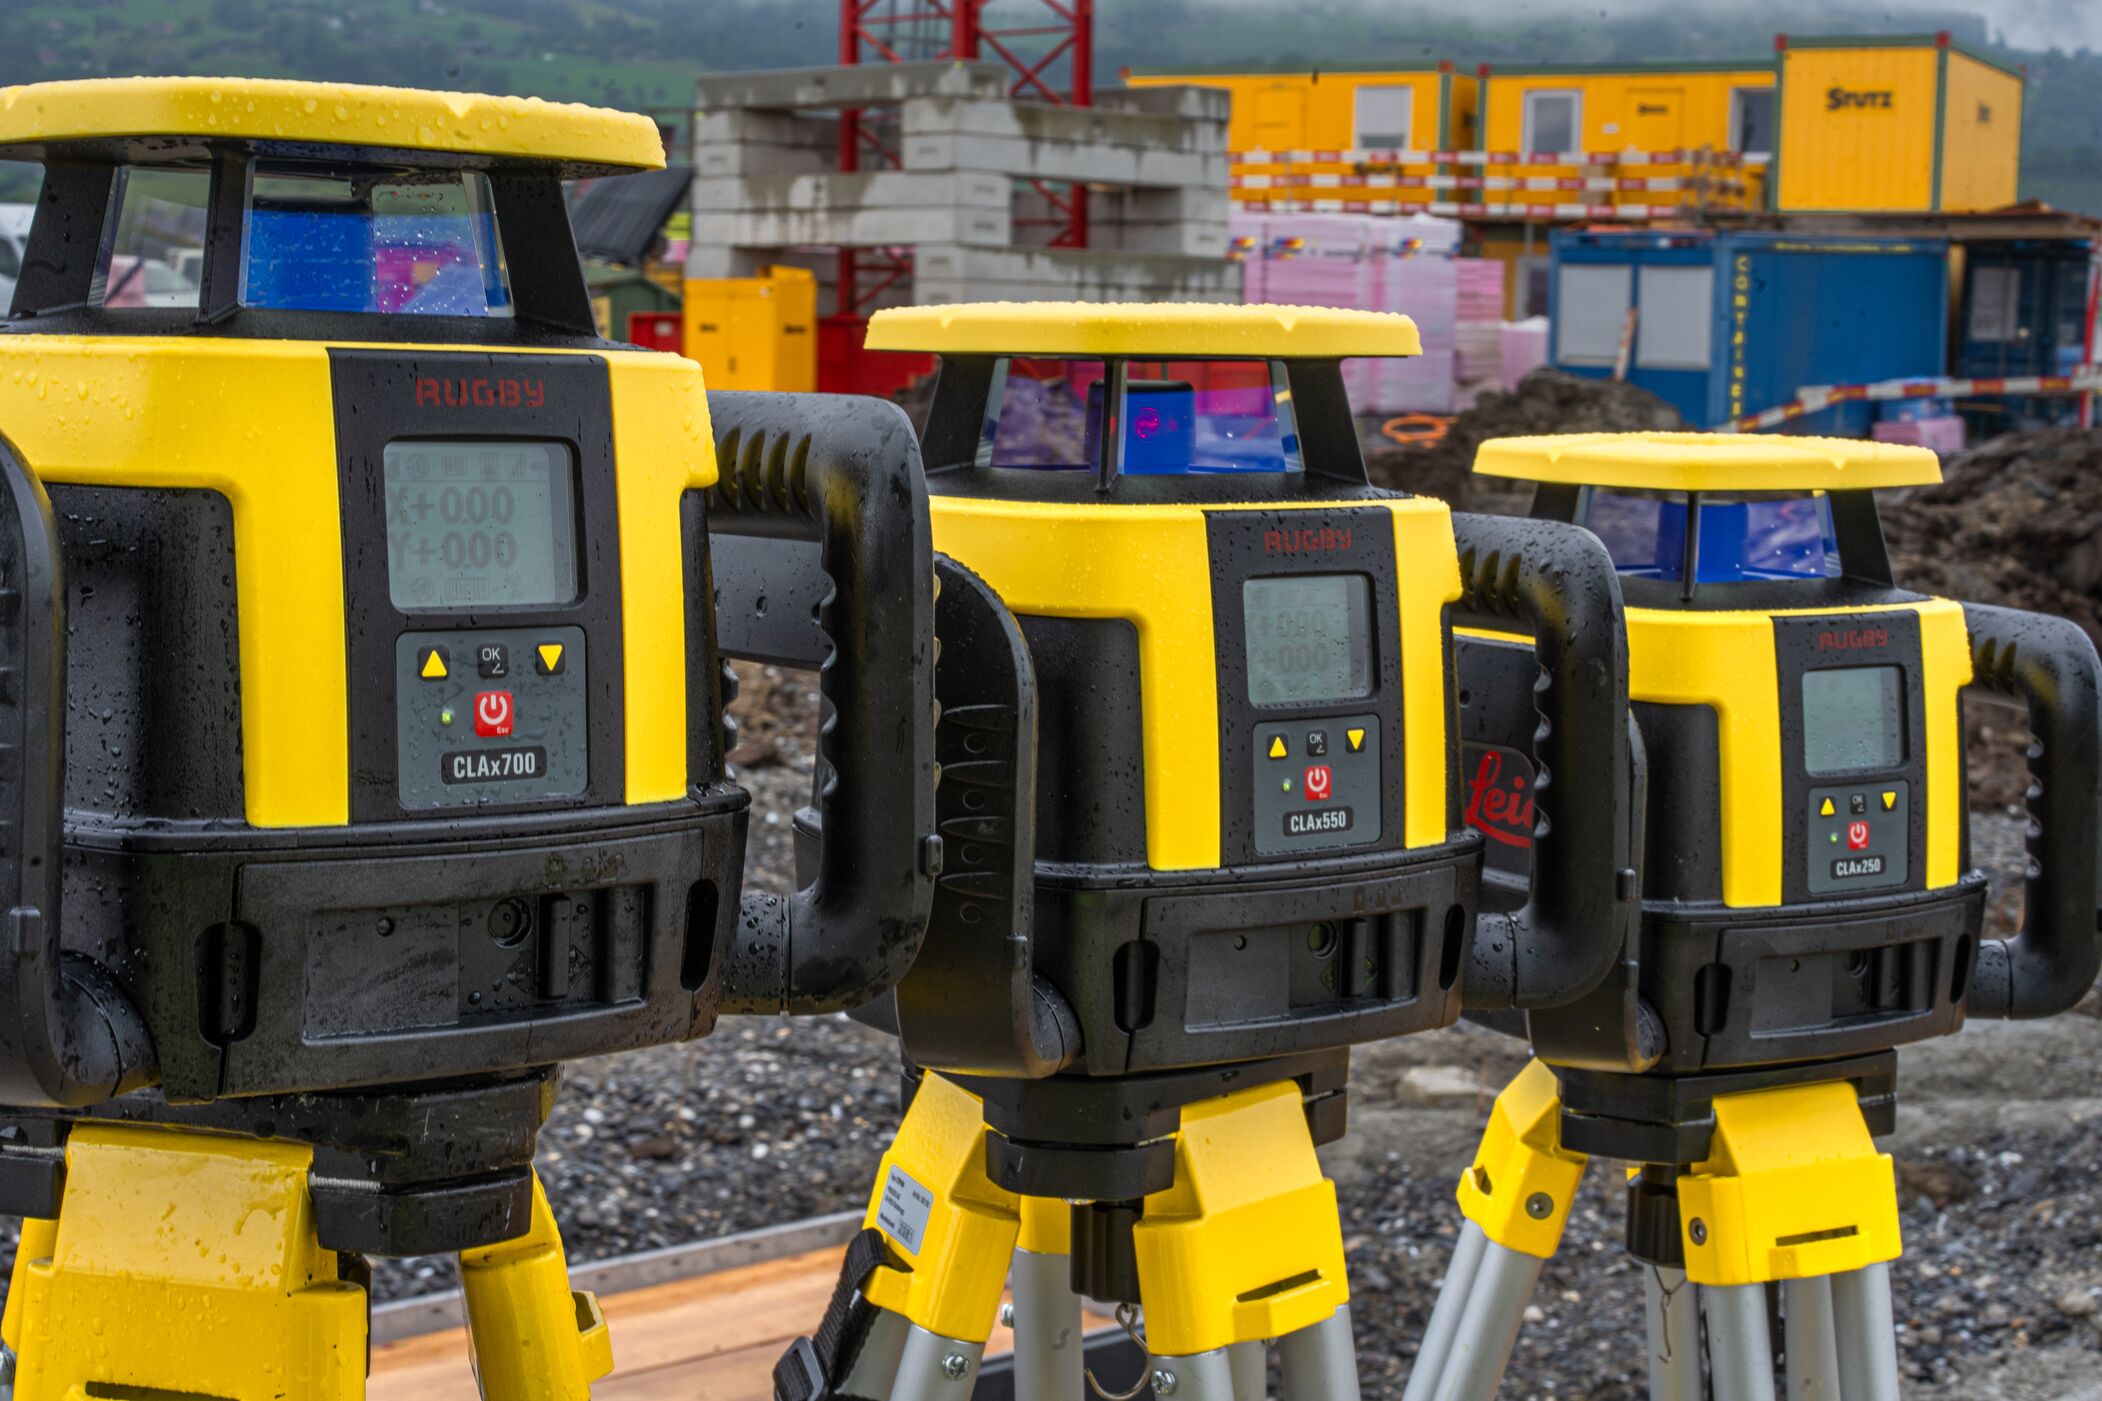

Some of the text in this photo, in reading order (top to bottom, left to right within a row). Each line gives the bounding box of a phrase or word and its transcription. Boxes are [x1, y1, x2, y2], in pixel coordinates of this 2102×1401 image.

[415, 378, 545, 408] RUGBY
[1263, 527, 1352, 554] RUGBY
[1818, 629, 1888, 651] RUGBY
[482, 647, 500, 661] OK
[1309, 733, 1323, 744] OK
[453, 752, 536, 779] CLAx700
[1290, 811, 1346, 832] CLAx550
[1836, 858, 1881, 876] CLAx250
